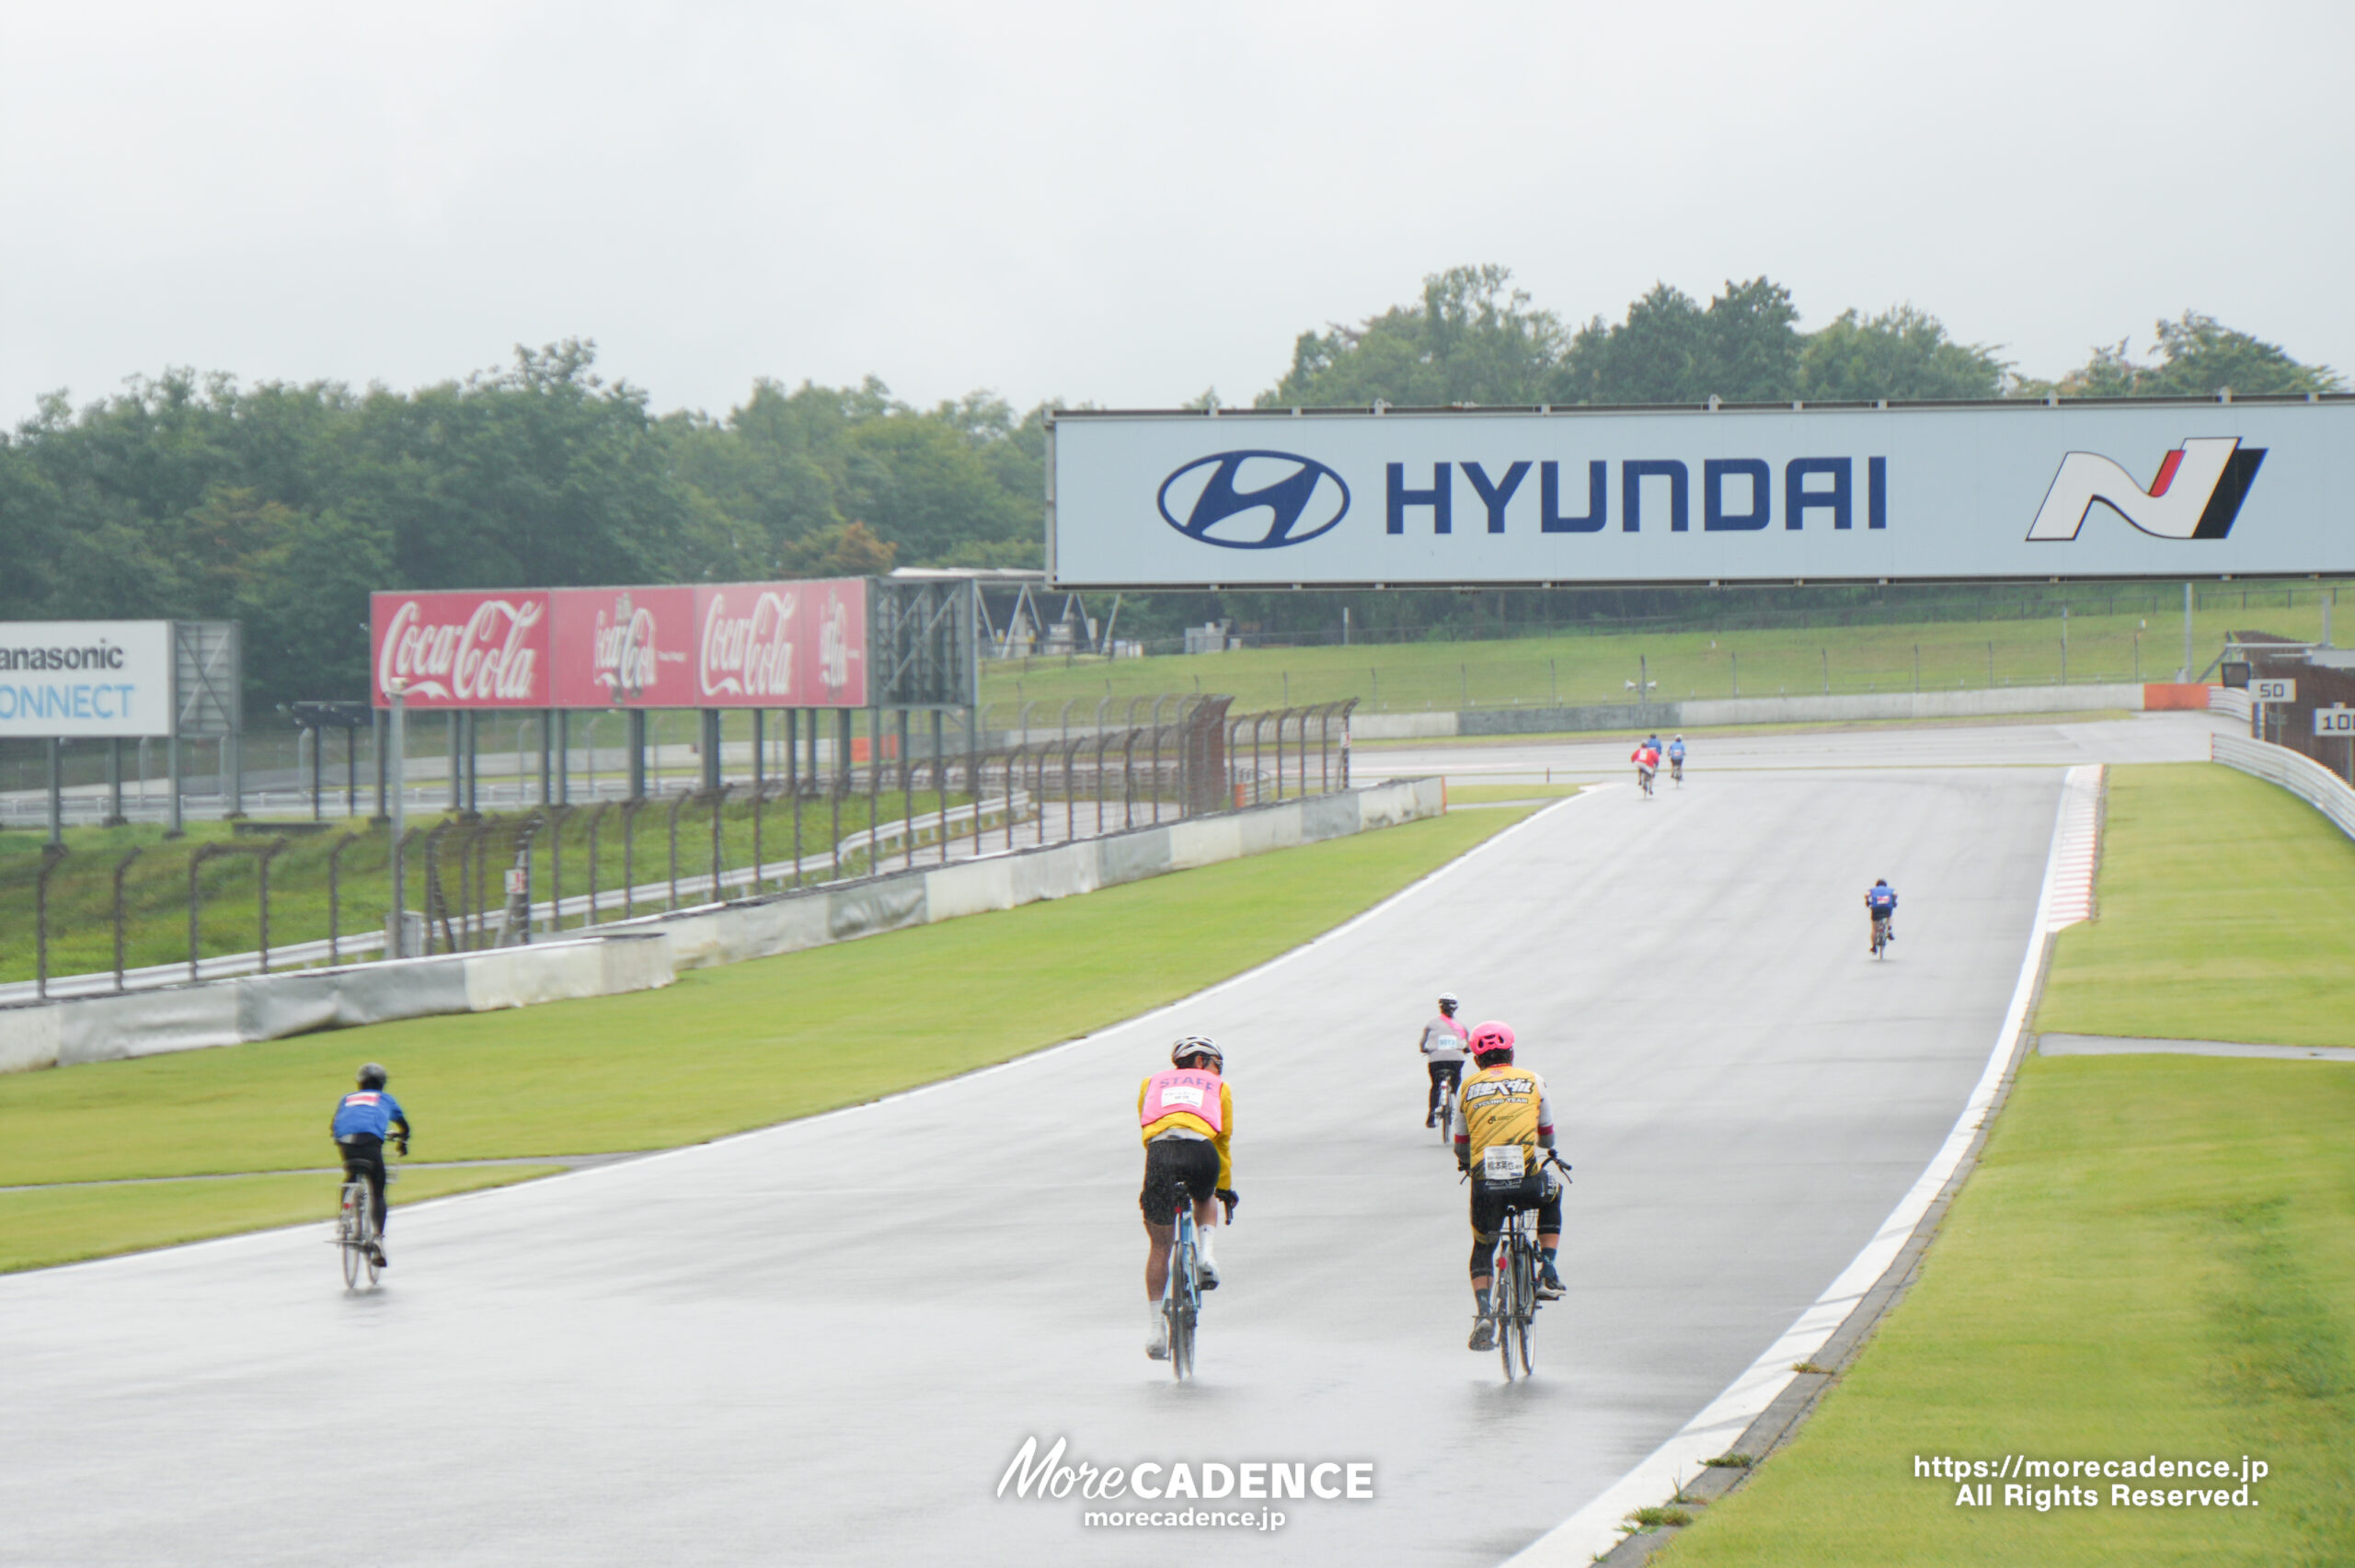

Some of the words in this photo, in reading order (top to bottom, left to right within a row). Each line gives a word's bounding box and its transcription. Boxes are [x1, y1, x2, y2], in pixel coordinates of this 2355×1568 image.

[1386, 455, 1887, 535] HYUNDAI
[379, 601, 546, 700] Coca-Cola
[700, 591, 798, 696] Coca-Cola
[2260, 683, 2285, 698] 50
[2322, 714, 2355, 730] 10
[1160, 1077, 1213, 1091] STAFF
